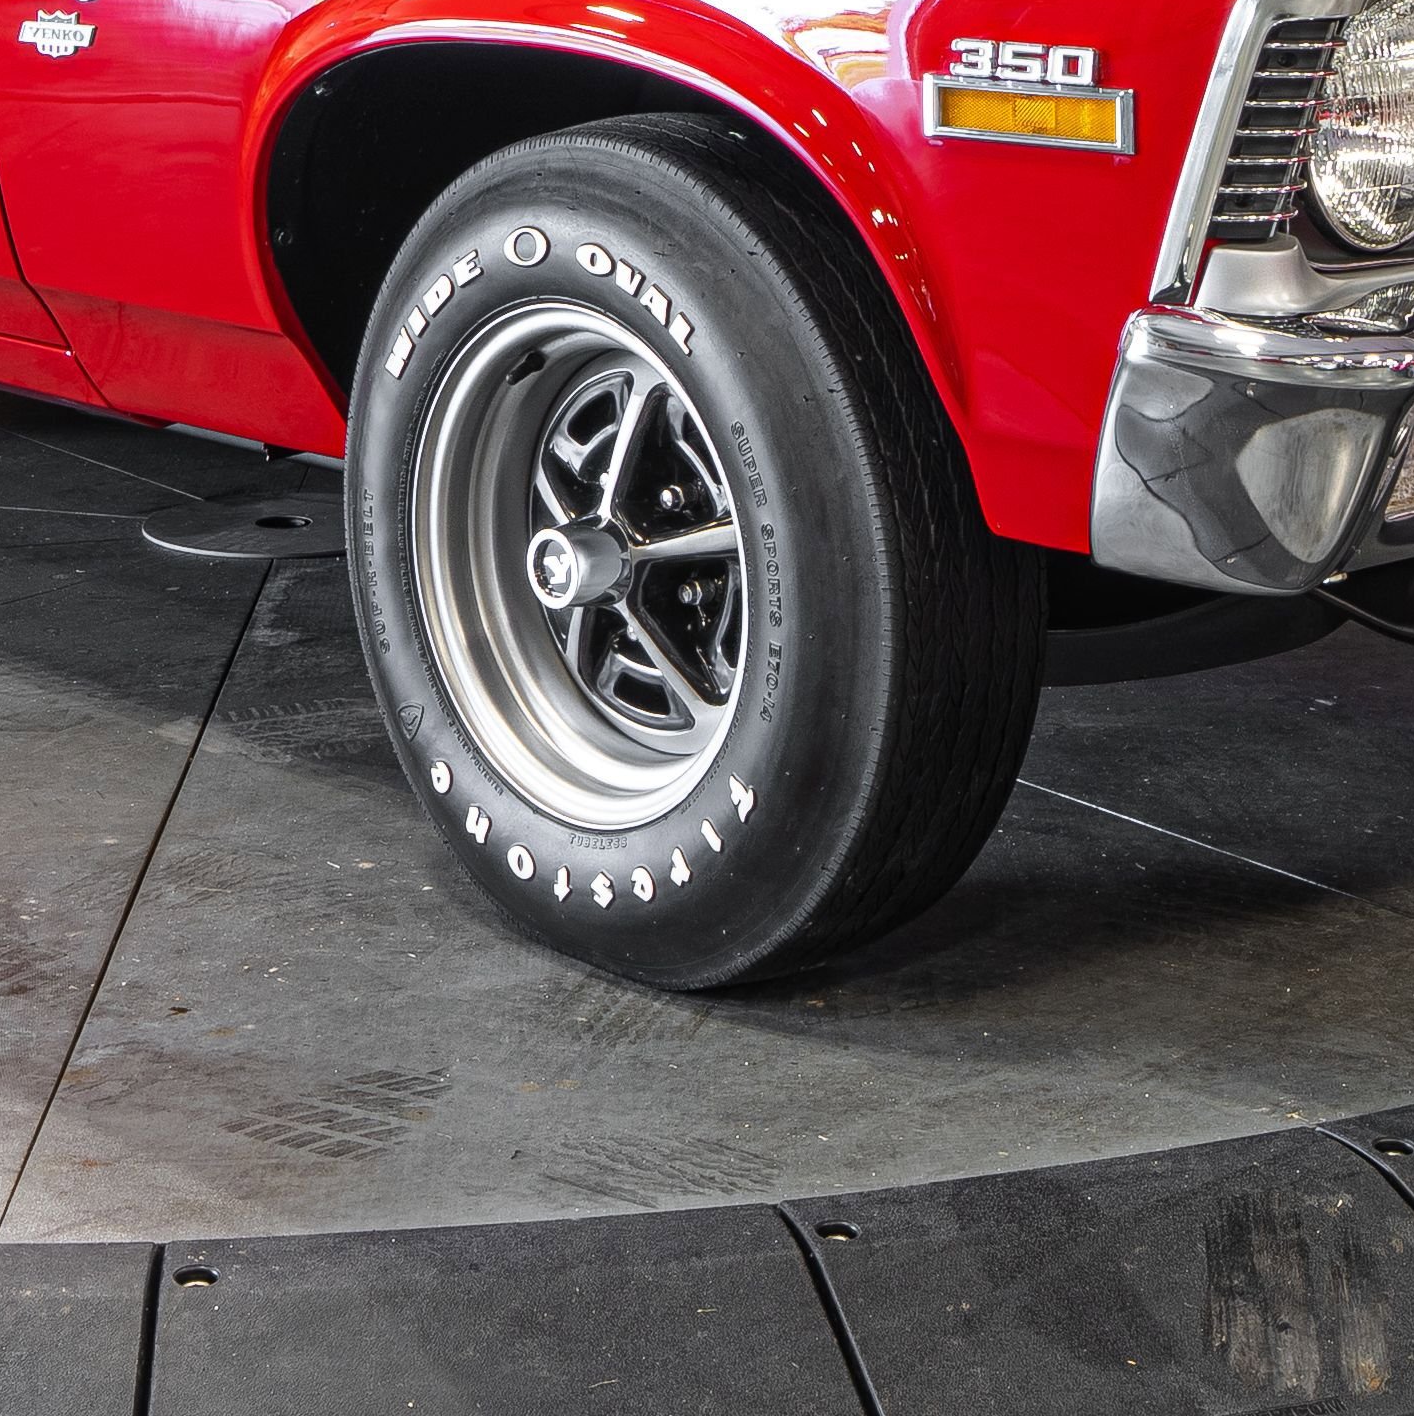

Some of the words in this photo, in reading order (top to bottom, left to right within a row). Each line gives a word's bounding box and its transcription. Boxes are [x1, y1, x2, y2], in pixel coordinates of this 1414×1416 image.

[28, 26, 85, 43] YENKO
[950, 38, 1099, 86] 350
[385, 249, 485, 380] WIDE
[576, 243, 696, 356] OVAL
[731, 420, 768, 508] SUPER
[761, 523, 783, 628] SPORTS
[430, 760, 756, 910] Firestone
[568, 834, 628, 850] TUBELESS
